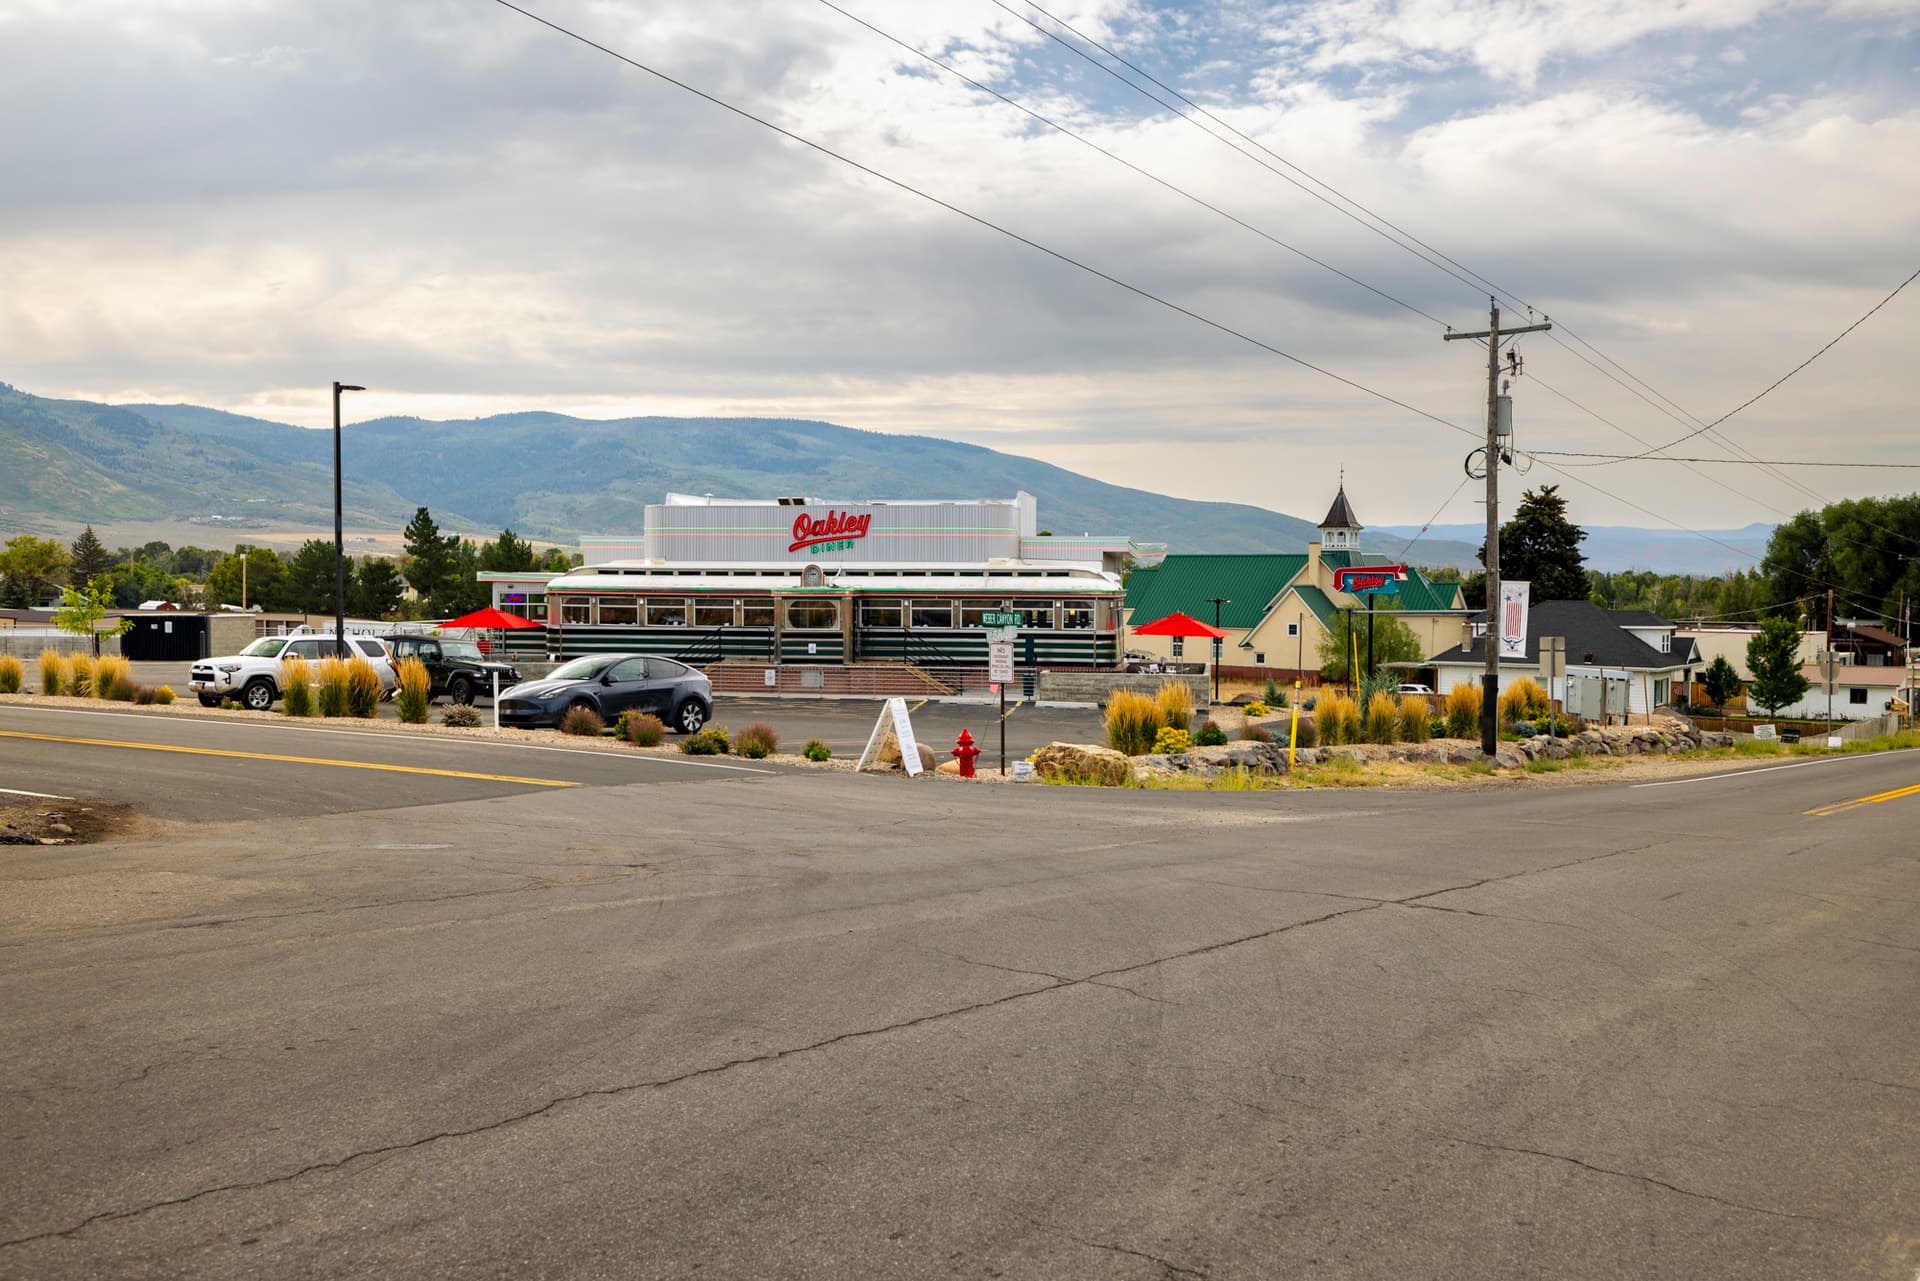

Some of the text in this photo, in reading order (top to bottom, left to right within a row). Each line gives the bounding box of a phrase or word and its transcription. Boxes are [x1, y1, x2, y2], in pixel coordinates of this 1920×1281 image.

[788, 510, 871, 553] Oakley
[811, 540, 854, 554] DINER
[997, 613, 1013, 625] CANYON
